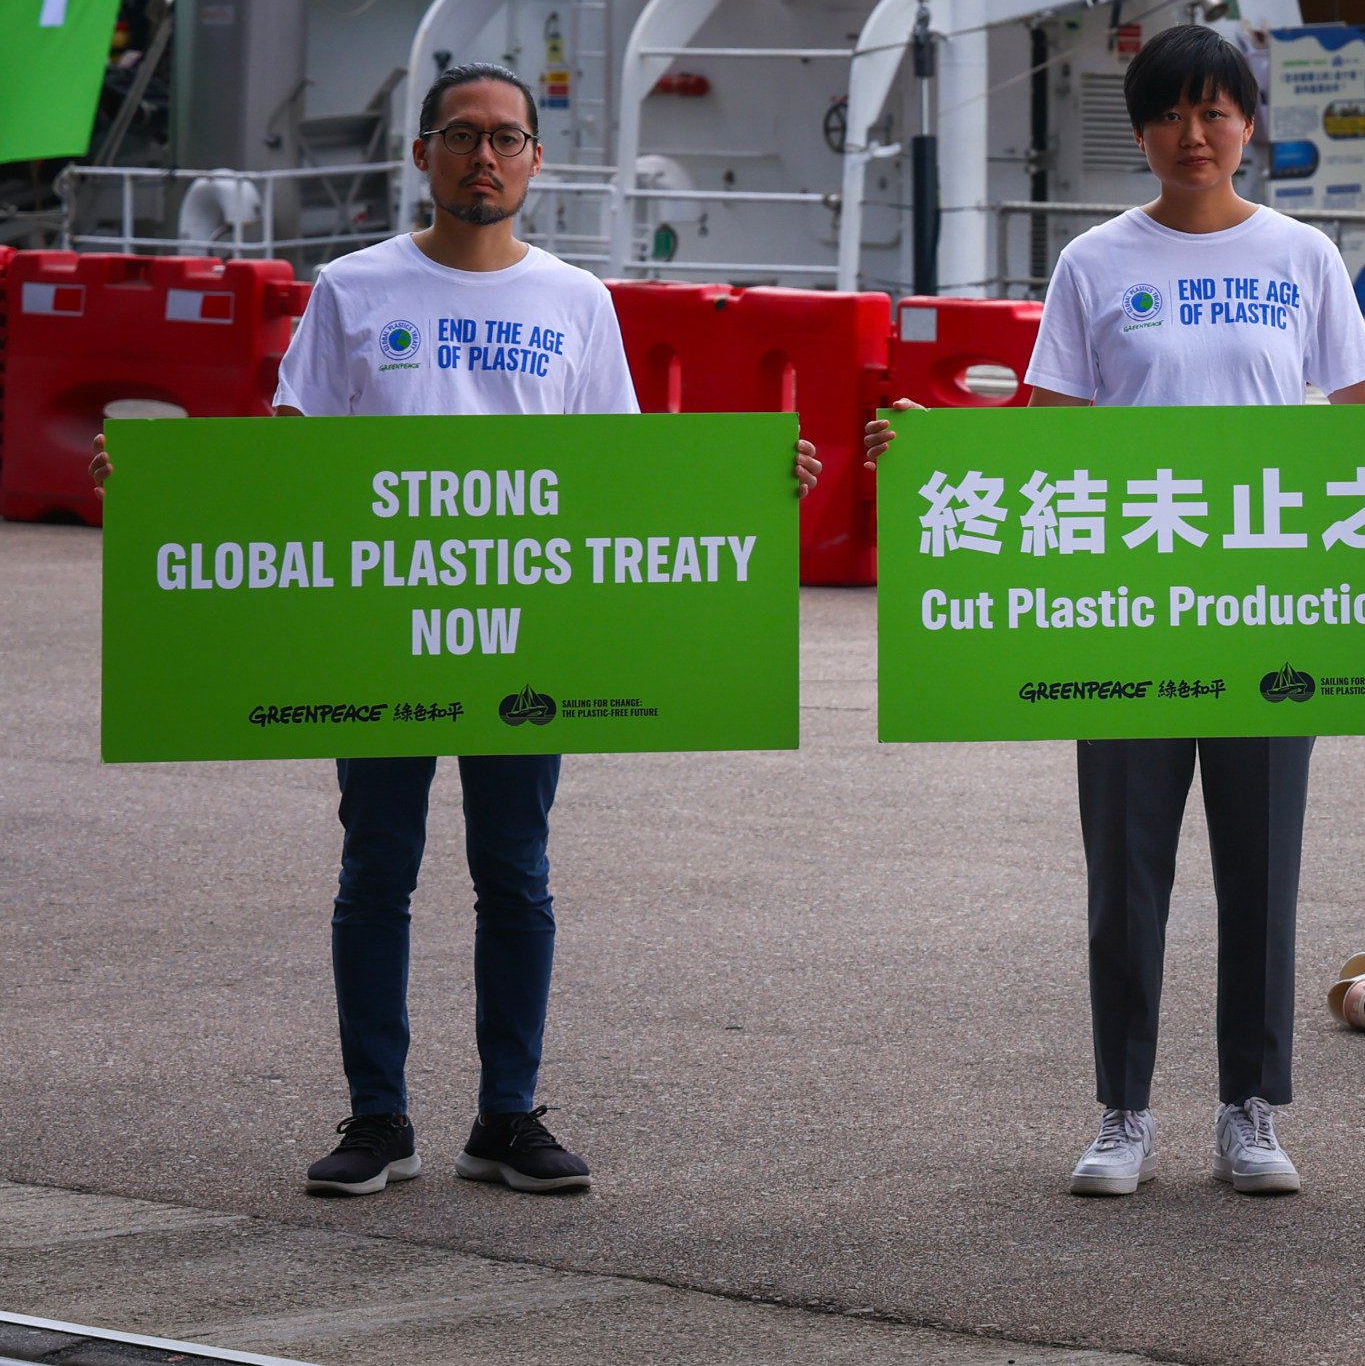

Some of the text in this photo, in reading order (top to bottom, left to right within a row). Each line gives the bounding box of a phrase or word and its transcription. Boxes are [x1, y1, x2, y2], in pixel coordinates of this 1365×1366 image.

[1178, 277, 1300, 308] END THE AGE
[1123, 319, 1164, 332] GREENPEACE
[1180, 302, 1287, 330] OF PLASTIC
[438, 318, 565, 355] END THE AGE
[379, 362, 421, 372] GREENPEACE
[438, 345, 550, 378] OF PLASTIC
[372, 469, 559, 518] STRONG
[157, 535, 757, 591] GLOBAL PLASTICS TREATY
[921, 587, 993, 631] Cut
[1008, 585, 1155, 629] Plastic
[412, 607, 521, 656] NOW
[1018, 679, 1227, 704] GREENPEACE 綠色和平
[1320, 677, 1348, 686] SAILING
[1350, 677, 1365, 686] FOR
[1320, 686, 1334, 695] THE
[248, 701, 465, 728] GREENPEACE 綠色和平
[561, 699, 592, 708] SAILING
[593, 699, 608, 708] FOR
[561, 708, 659, 718] THE PLASTIC-FREE FUTURE
